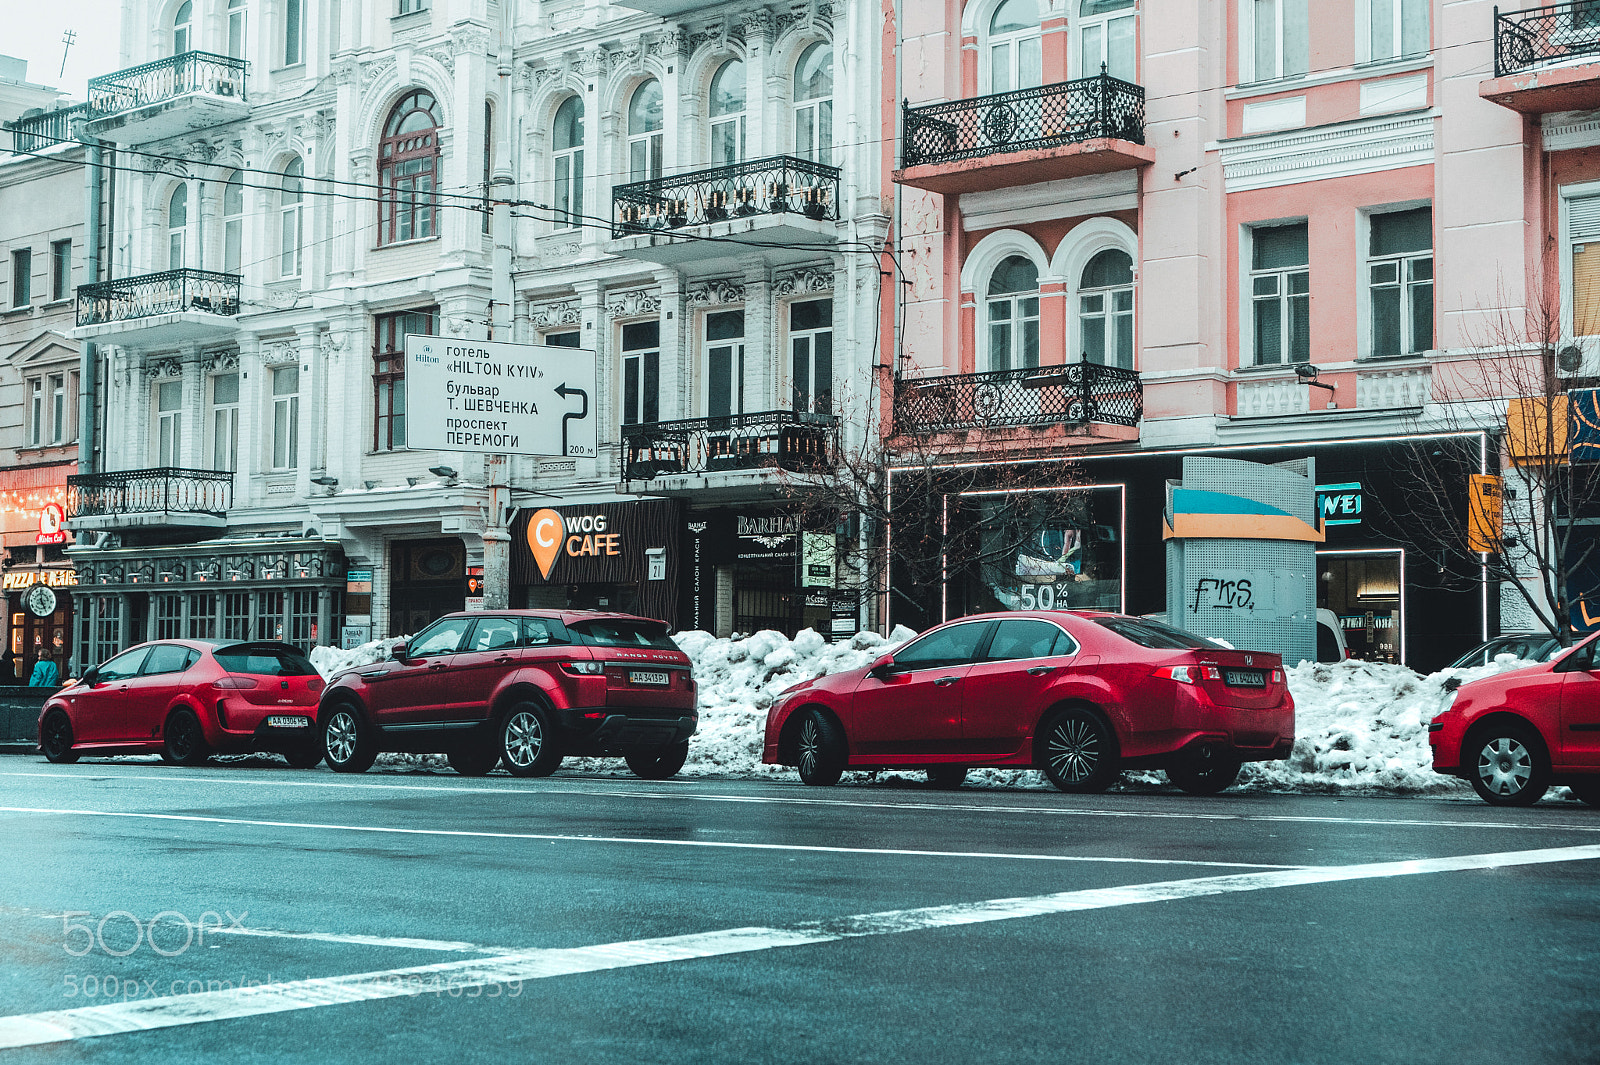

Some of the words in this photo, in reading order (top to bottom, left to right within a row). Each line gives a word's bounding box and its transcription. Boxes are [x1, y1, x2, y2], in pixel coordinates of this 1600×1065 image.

[415, 354, 440, 363] Hilton
[446, 346, 490, 359] готель
[446, 361, 501, 376] «HILTON
[507, 364, 544, 379] KYIV»
[446, 380, 499, 398] бульвар
[447, 398, 459, 411] Т.
[464, 398, 538, 415] ШЕВЧЕНКА
[446, 418, 507, 431] проспект
[446, 431, 519, 448] ПЕРЕМОГИ
[569, 445, 584, 454] 200
[566, 515, 607, 534] WOG
[566, 533, 620, 557] CAFE
[3, 572, 36, 589] PIZZA
